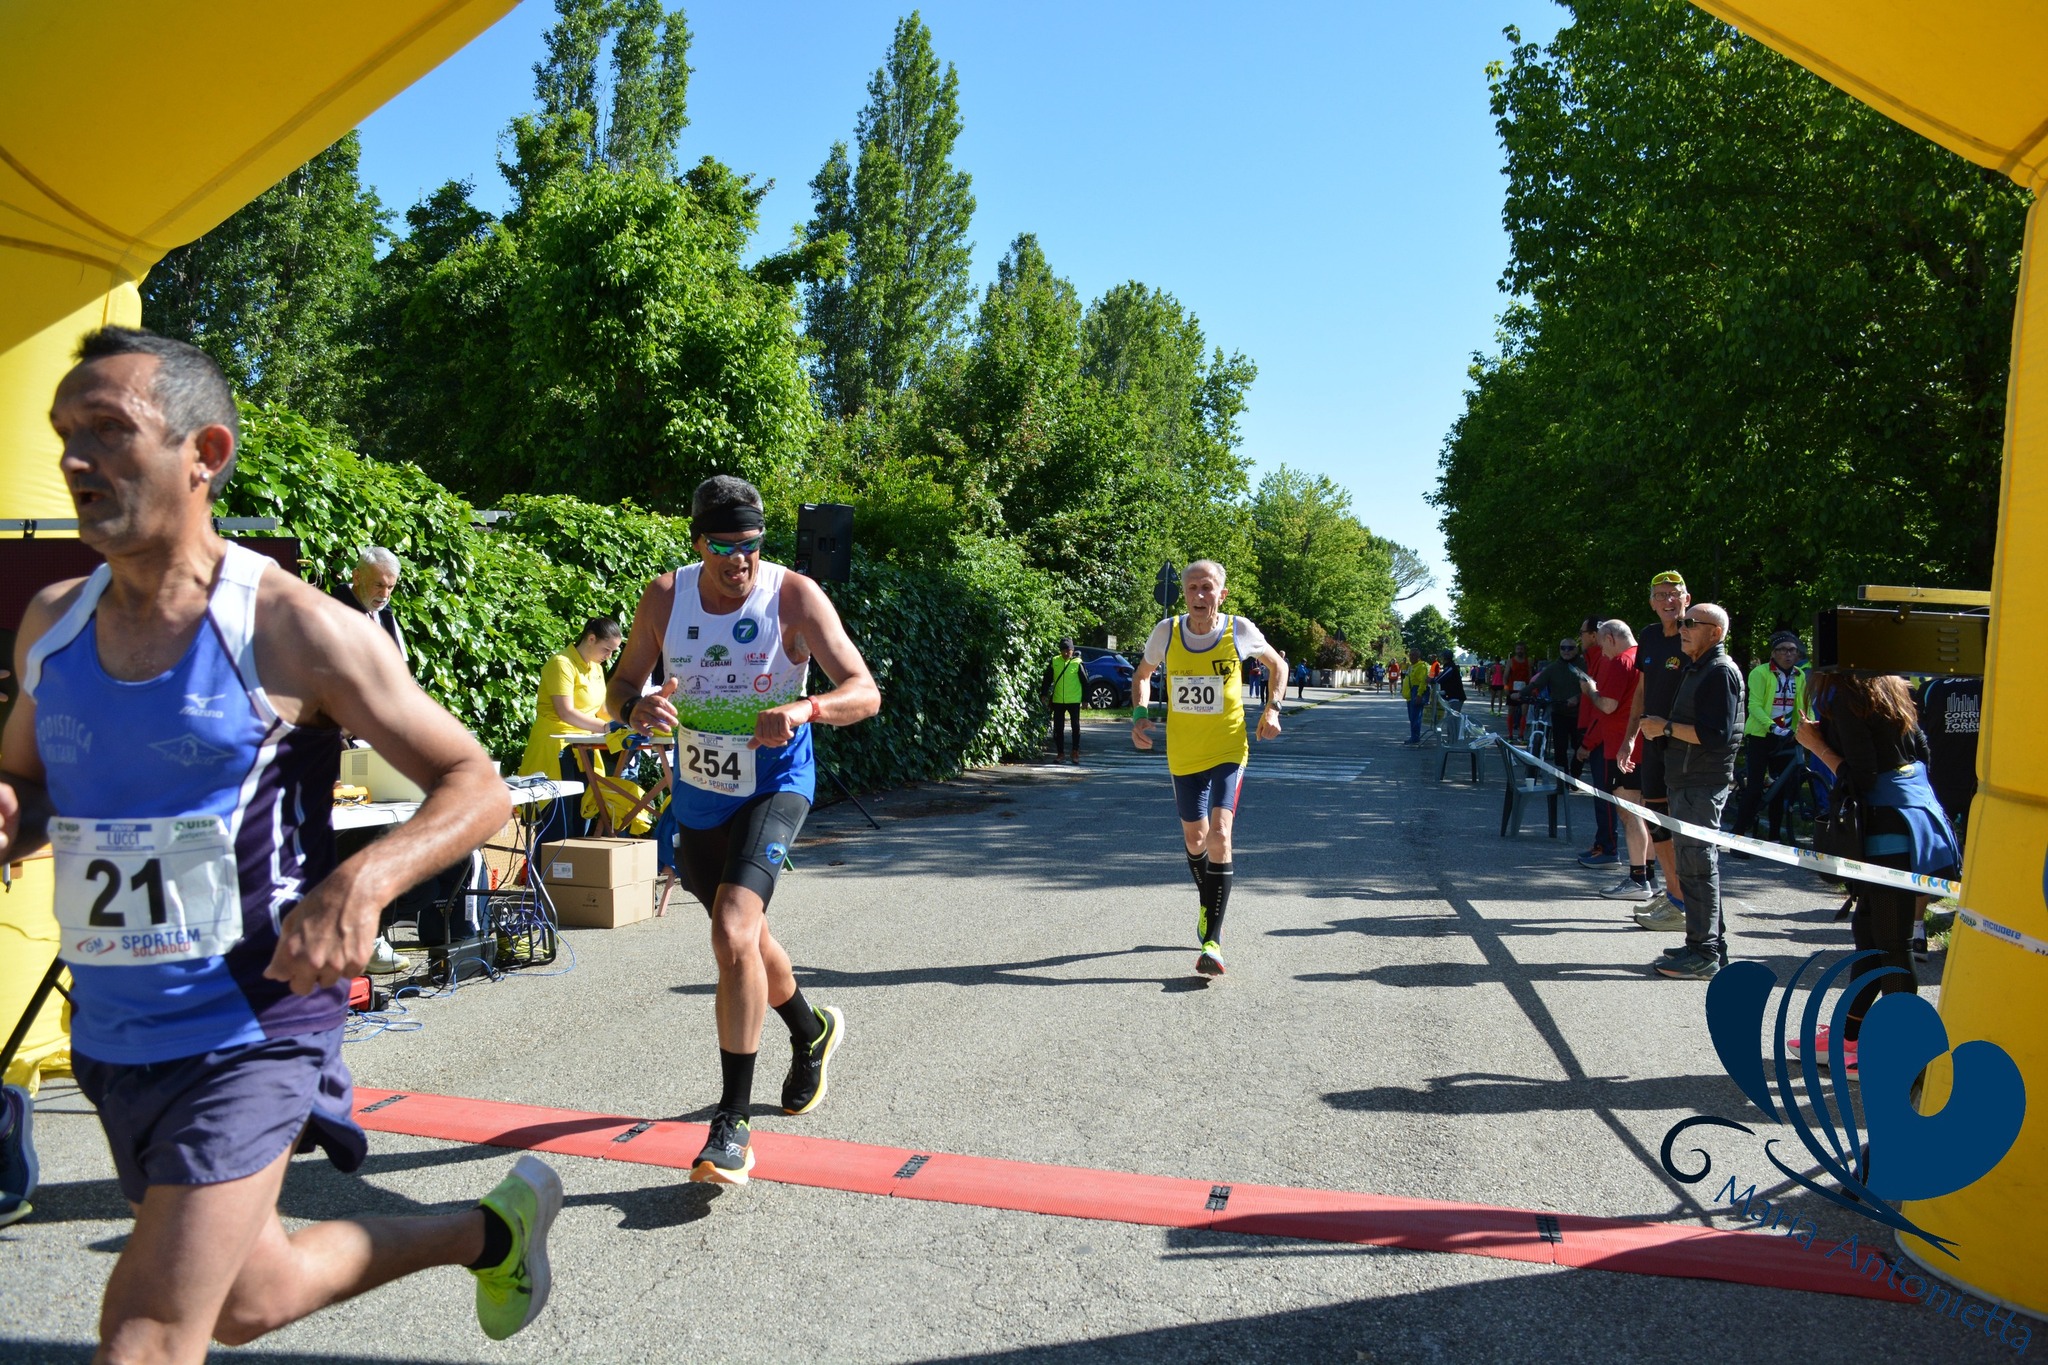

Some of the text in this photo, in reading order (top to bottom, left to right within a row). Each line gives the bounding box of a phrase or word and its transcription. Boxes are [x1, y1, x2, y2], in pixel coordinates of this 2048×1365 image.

[700, 660, 732, 668] LEGNAMI
[1178, 685, 1215, 705] 230
[686, 744, 742, 781] 254
[708, 780, 740, 790] SPORTGM
[107, 832, 140, 846] LUCCI
[85, 858, 167, 928] 21
[121, 928, 201, 950] SPORTGM
[132, 941, 192, 958] SOLAROLO
